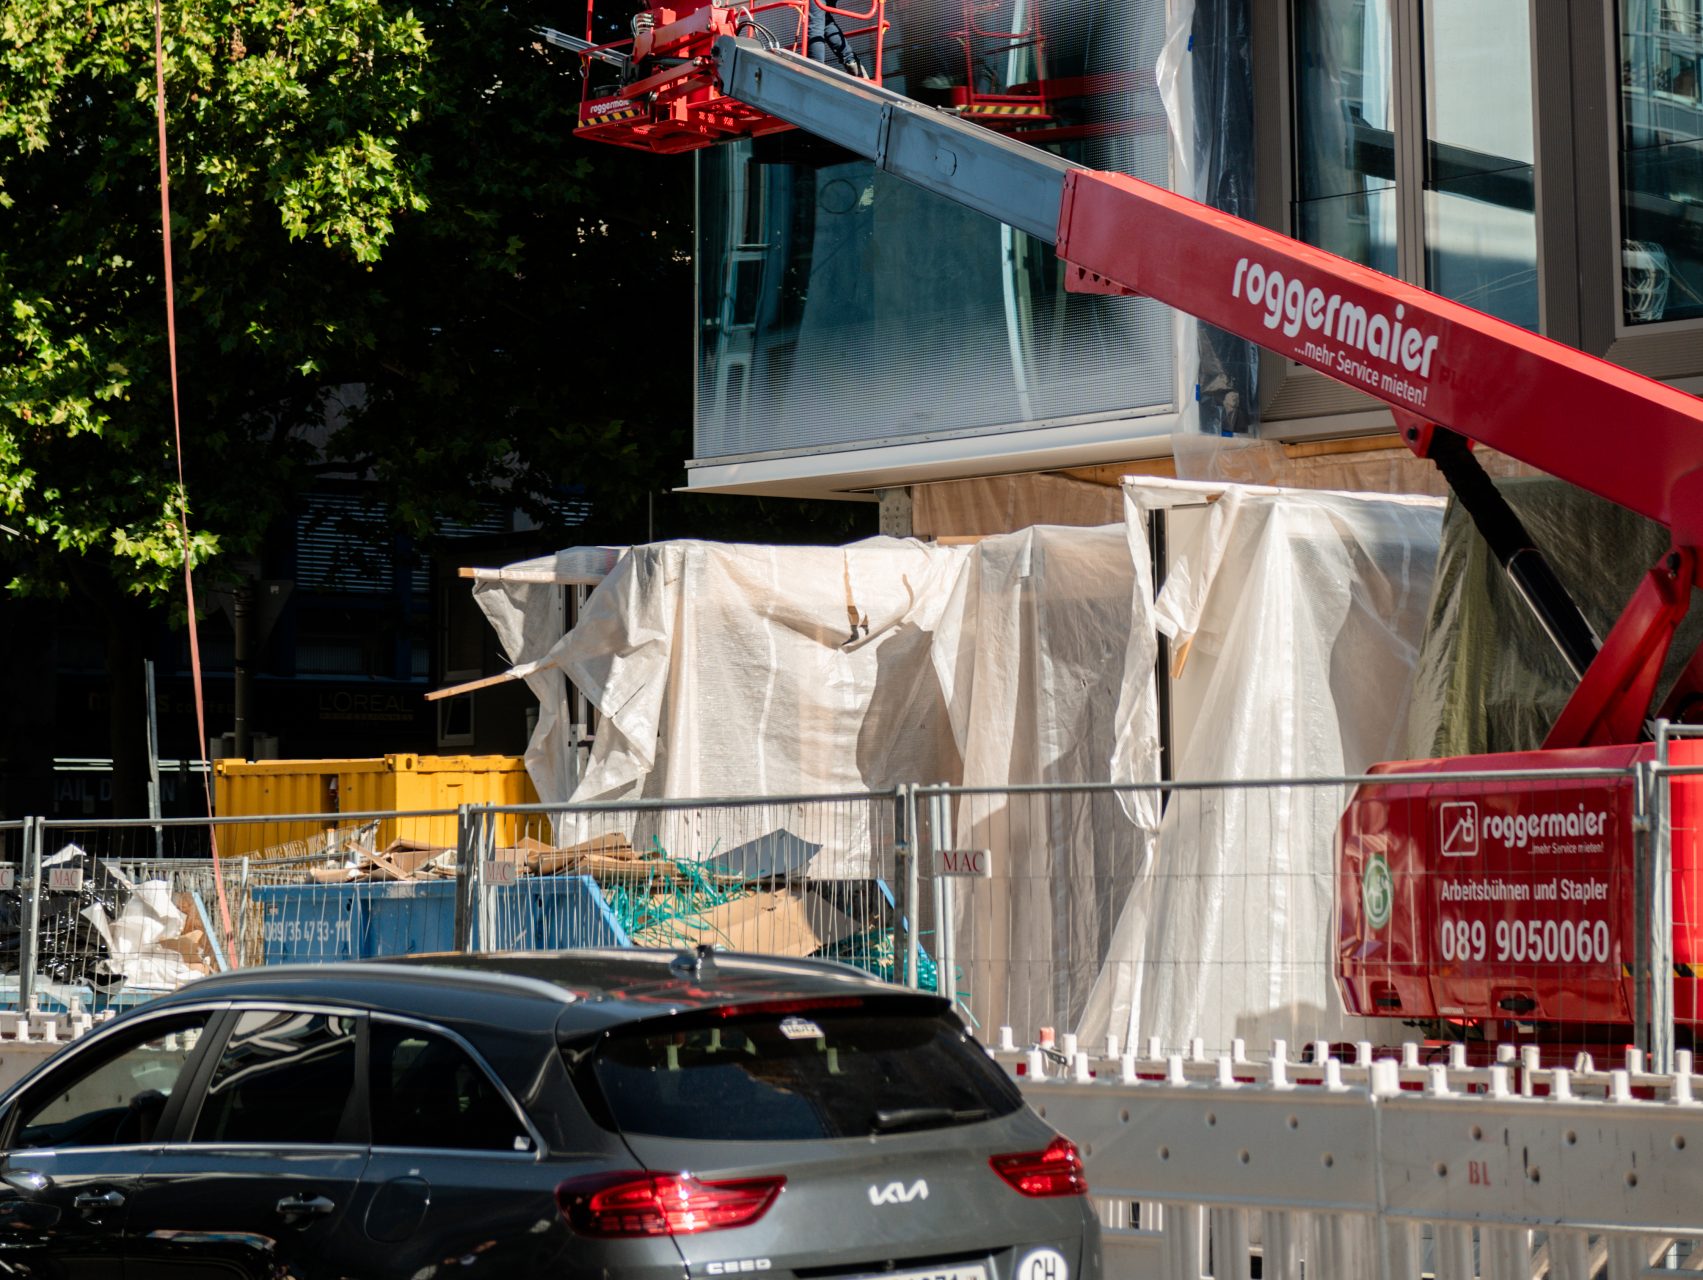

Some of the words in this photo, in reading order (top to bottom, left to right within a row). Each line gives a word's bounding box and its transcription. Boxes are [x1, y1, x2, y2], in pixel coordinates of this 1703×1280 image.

[1232, 258, 1439, 378] roggermaier
[1294, 341, 1335, 367] ...mehr
[1337, 350, 1379, 386] Service
[1381, 373, 1428, 407] mieten!
[1483, 803, 1607, 848] roggermaier
[1552, 842, 1577, 854] Service
[1578, 841, 1604, 853] mieten!
[487, 863, 511, 881] MAC
[943, 851, 984, 873] MAC
[54, 870, 78, 886] MAC
[1441, 878, 1530, 901] Arbeitsbühnen
[1533, 877, 1557, 900] und
[1560, 877, 1609, 905] Stapler
[1441, 919, 1487, 962] 089
[1495, 919, 1610, 963] 9050060
[869, 1179, 929, 1206] KIA
[1031, 1257, 1056, 1280] CH
